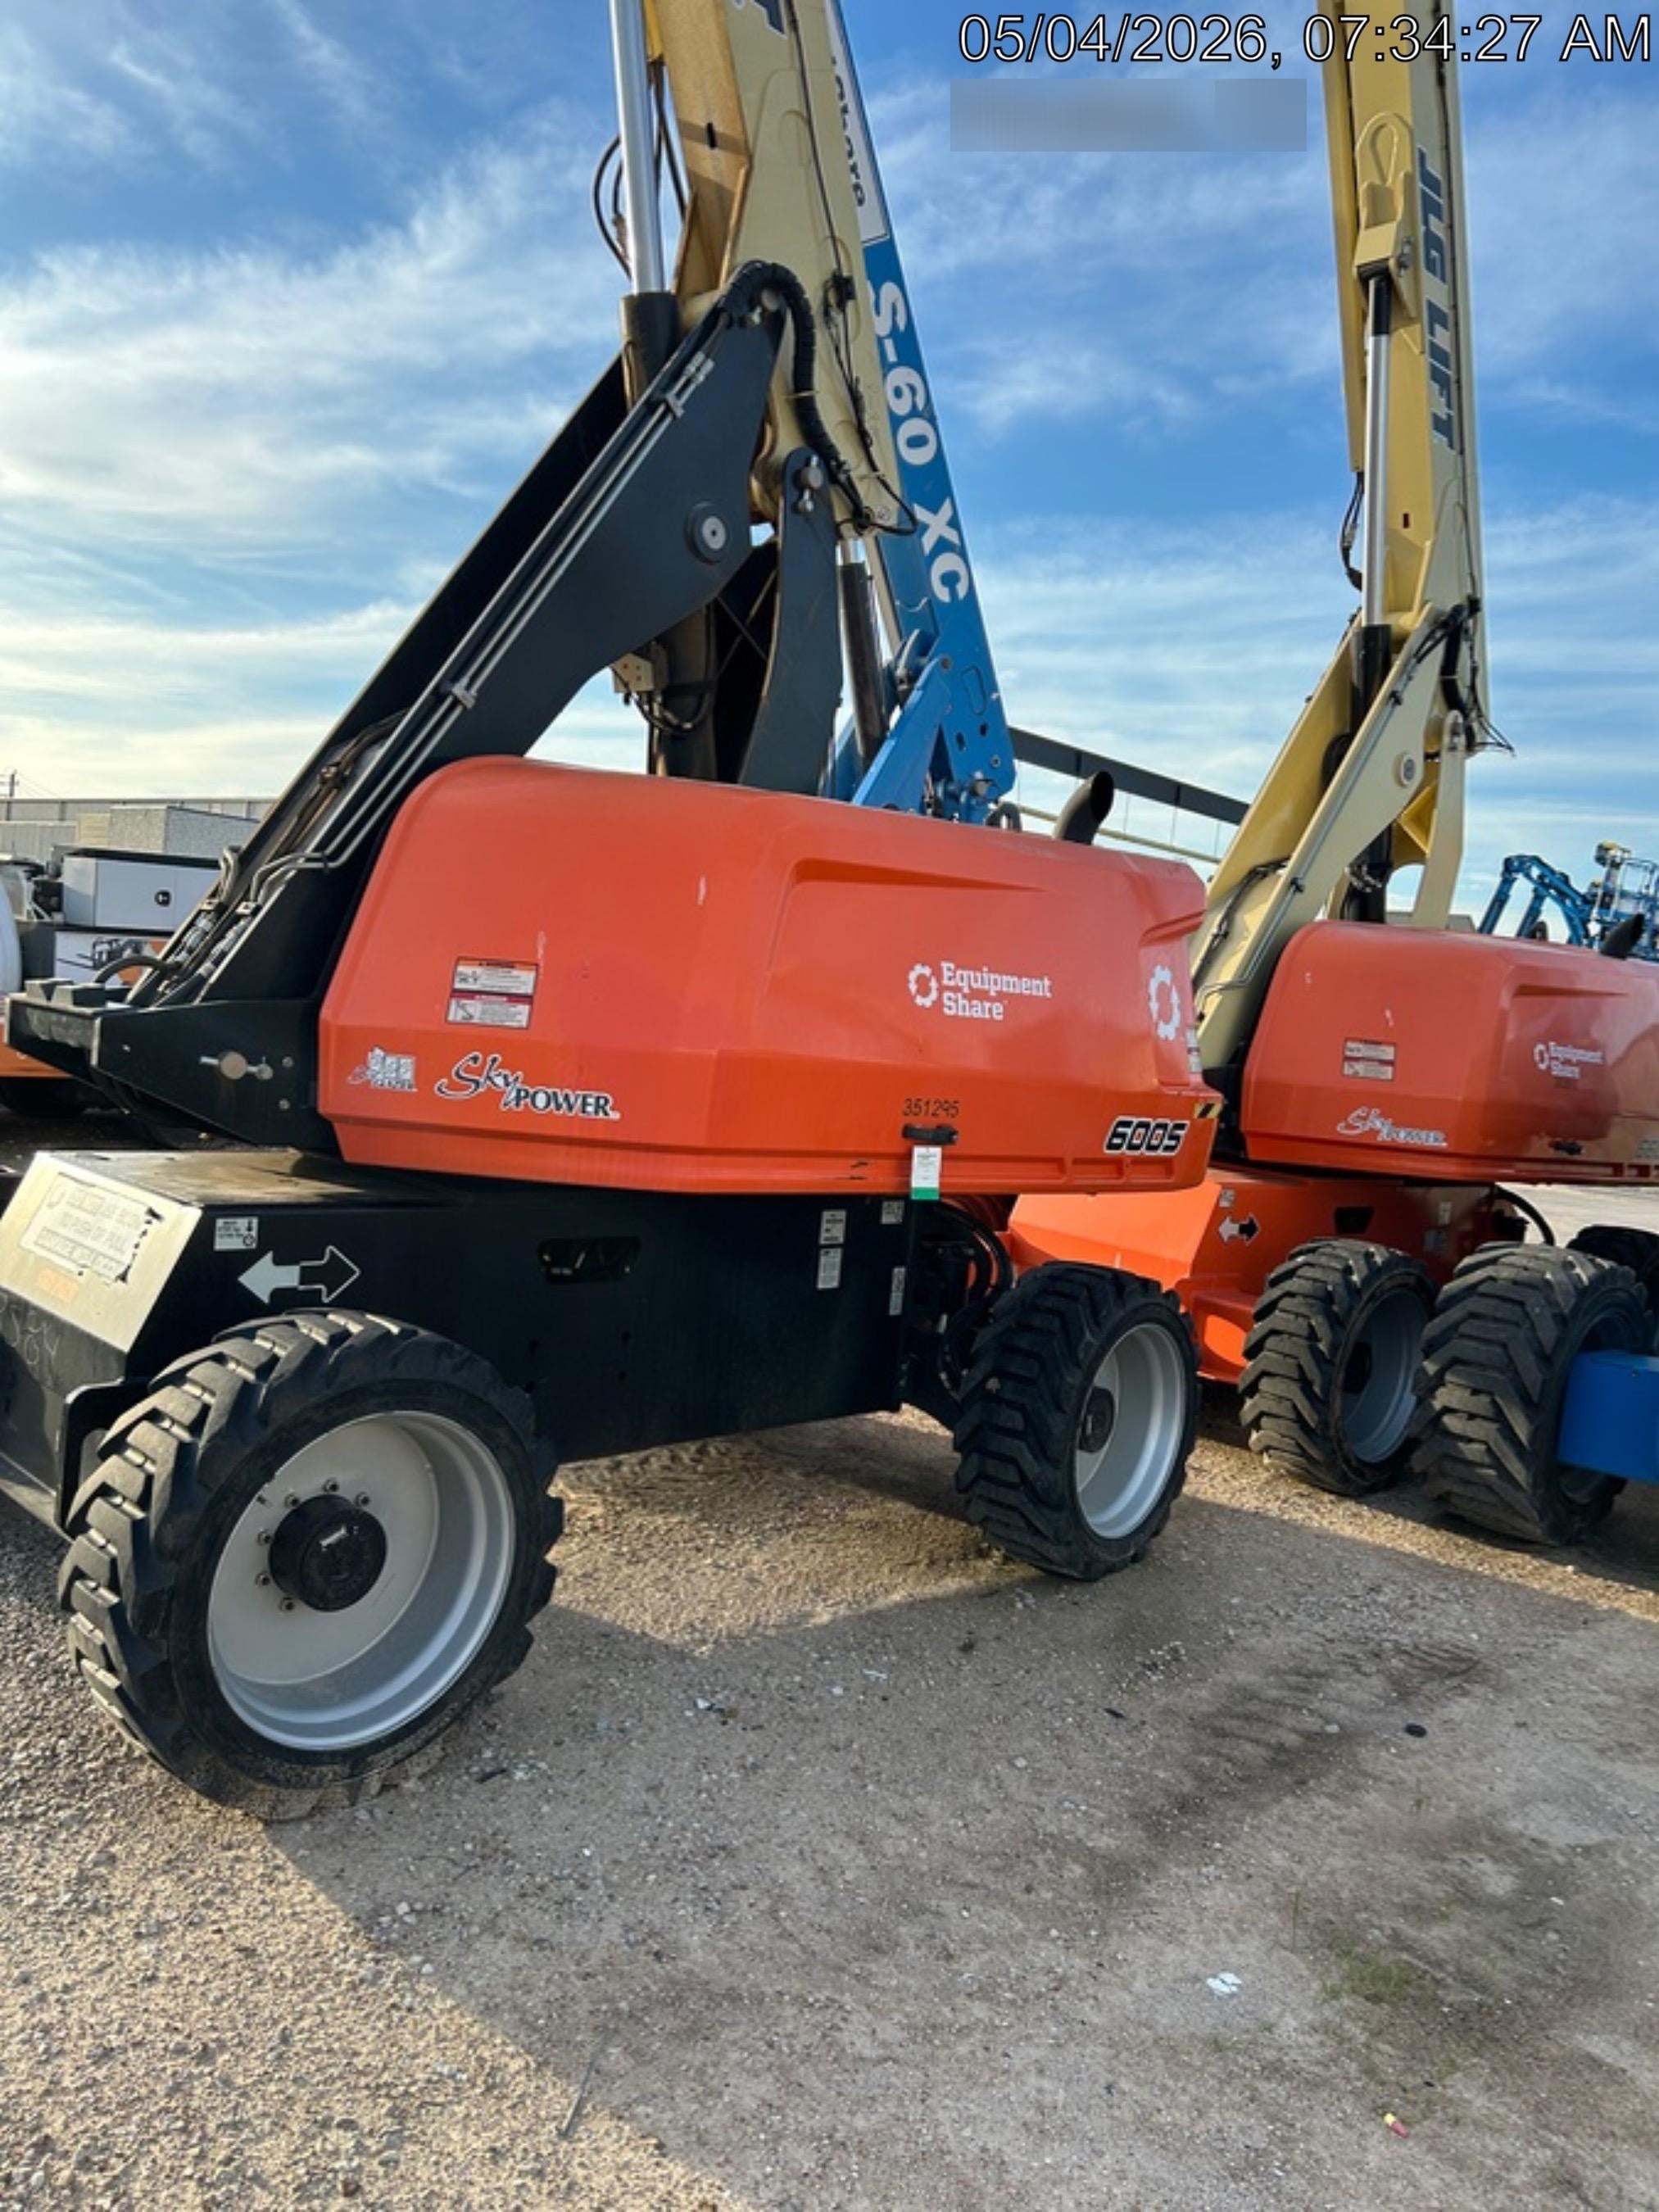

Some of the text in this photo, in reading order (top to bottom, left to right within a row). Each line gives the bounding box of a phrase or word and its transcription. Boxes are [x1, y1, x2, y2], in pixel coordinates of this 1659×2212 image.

[1417, 147, 1456, 451] JLG LIFT
[868, 280, 970, 604] S-60 XC
[941, 961, 1053, 999] Equipment
[943, 991, 1004, 1021] Share
[901, 1099, 960, 1119] 351295
[1104, 1117, 1189, 1155] 600S
